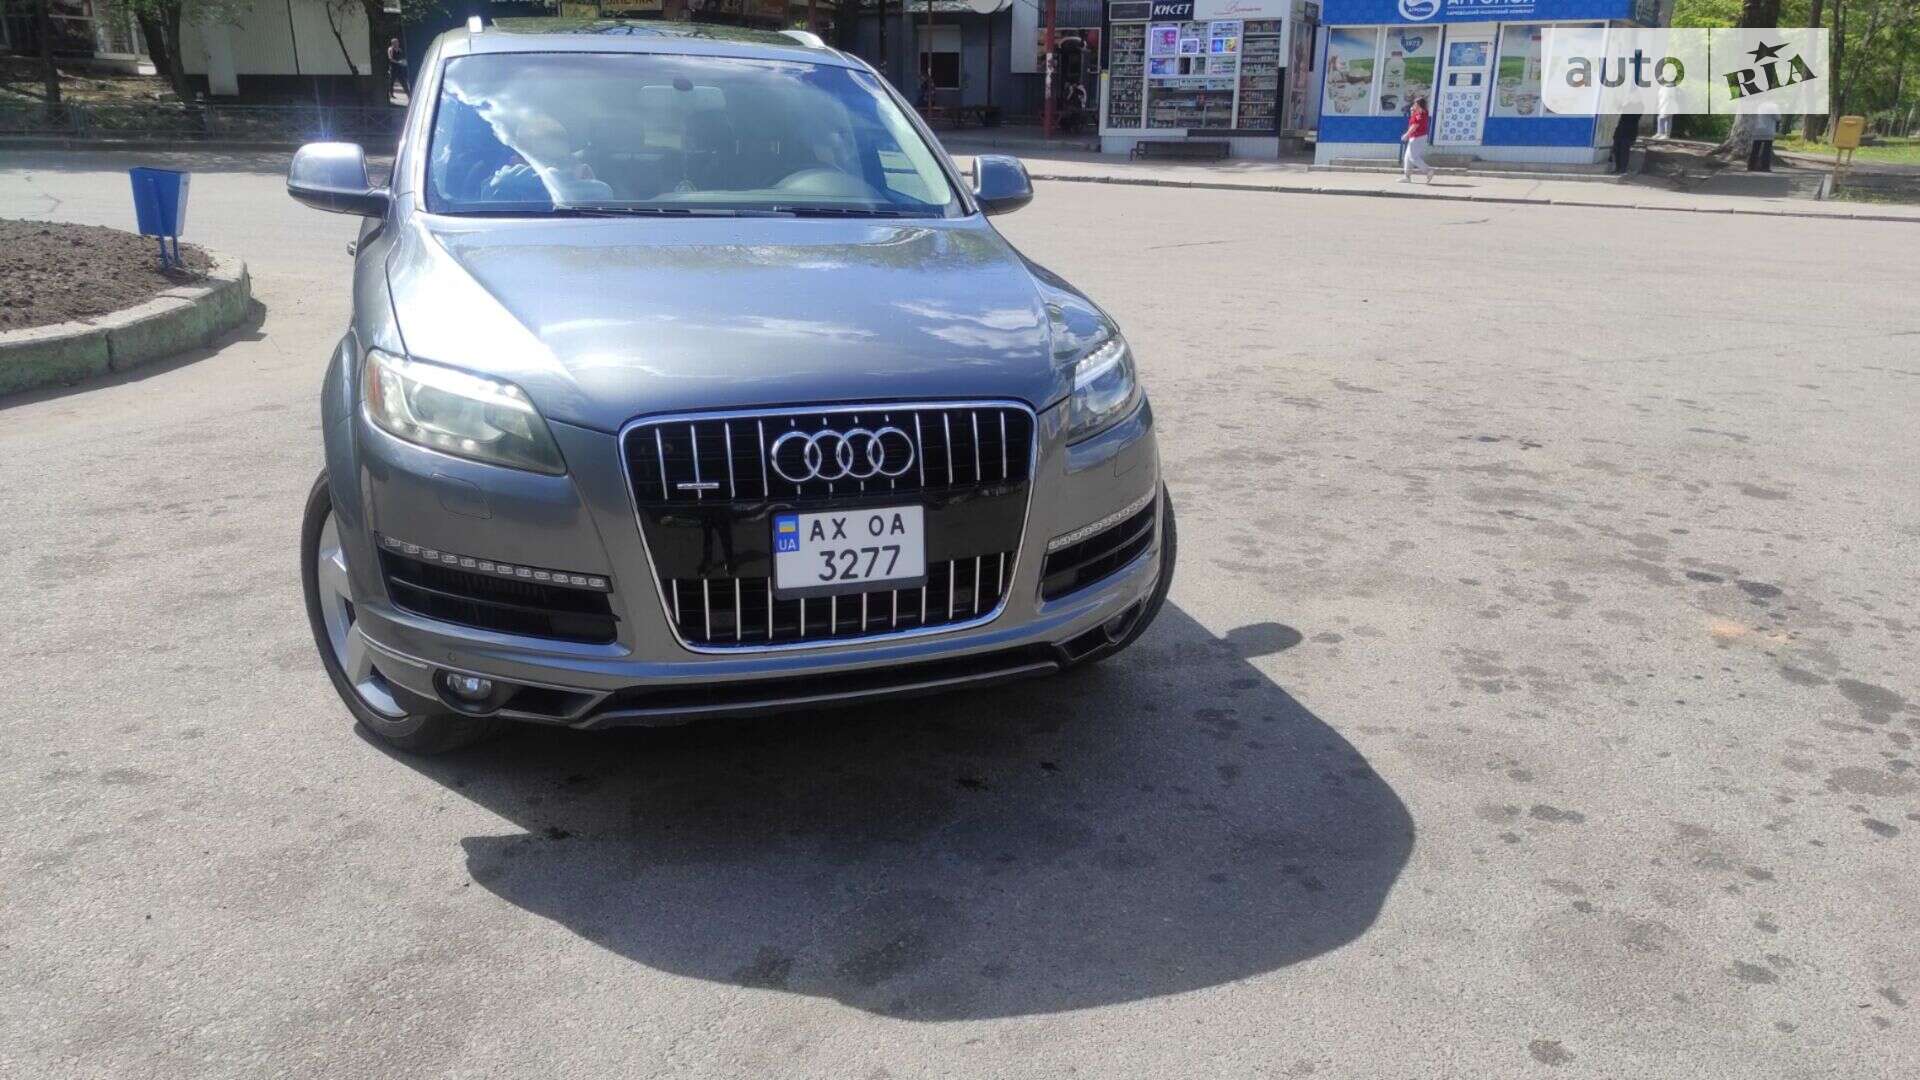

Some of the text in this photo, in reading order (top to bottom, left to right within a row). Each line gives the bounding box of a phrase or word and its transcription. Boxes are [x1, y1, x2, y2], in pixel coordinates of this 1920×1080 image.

[1153, 4, 1191, 15] КИСЕТ
[810, 512, 905, 542] AX OA
[779, 538, 796, 551] UA
[818, 544, 901, 582] 3277
